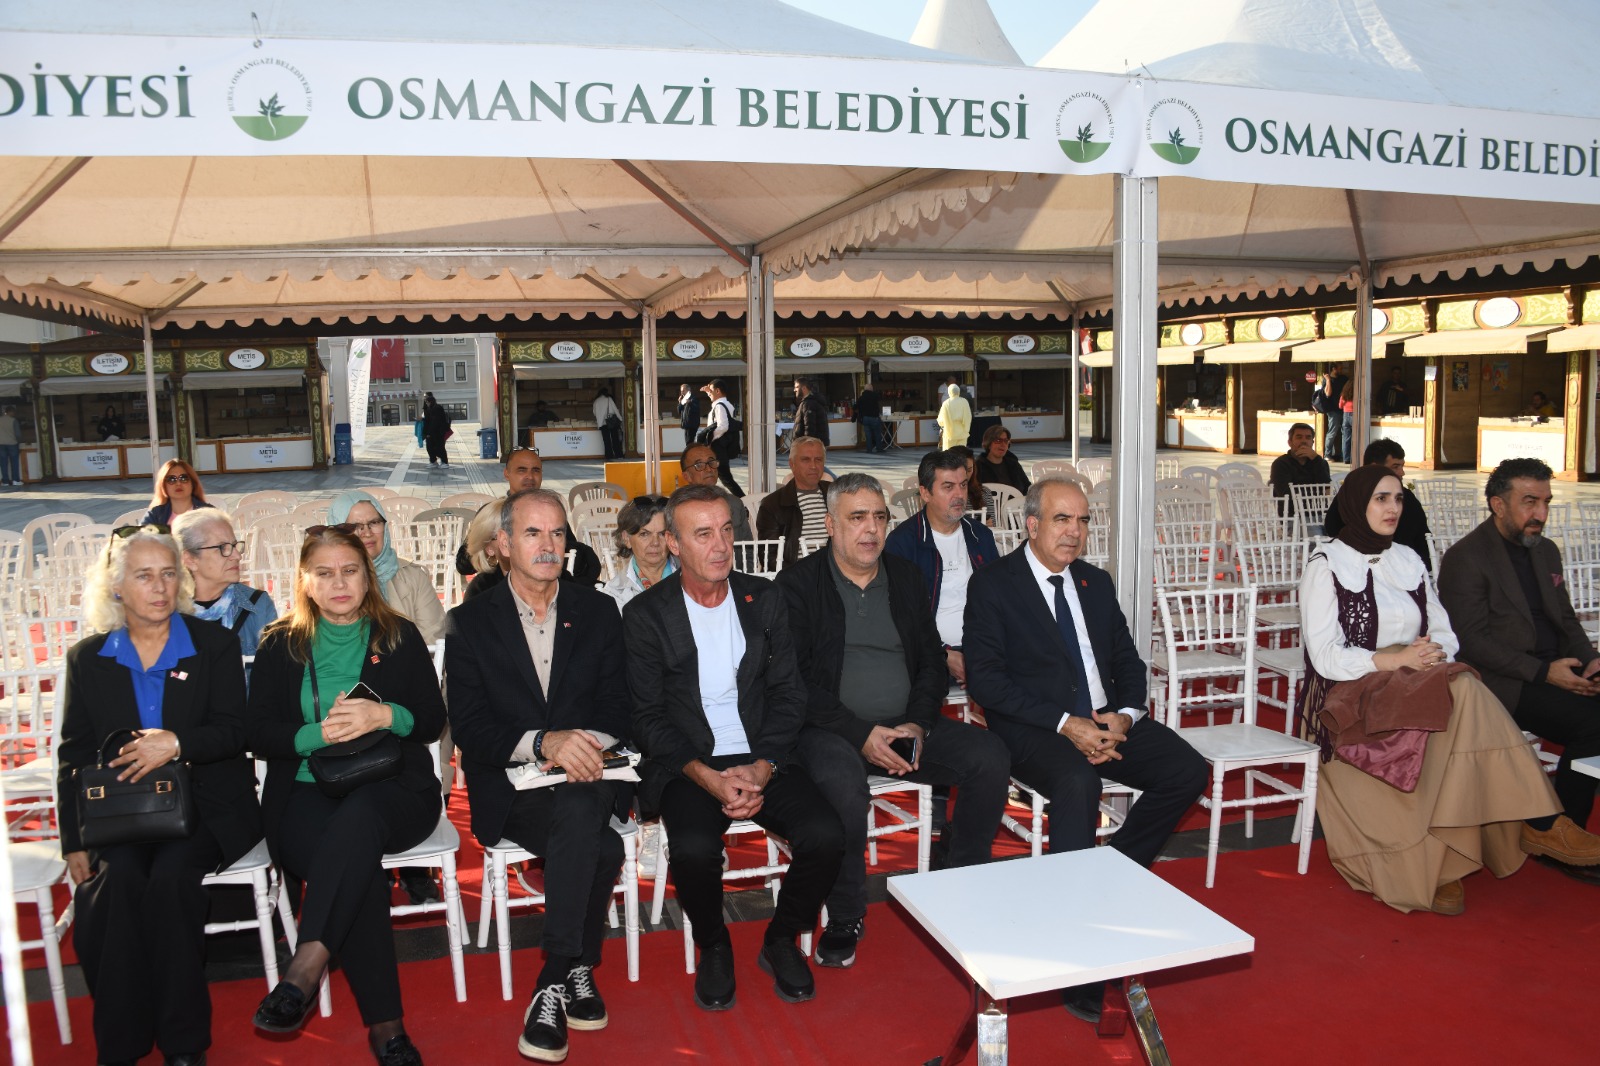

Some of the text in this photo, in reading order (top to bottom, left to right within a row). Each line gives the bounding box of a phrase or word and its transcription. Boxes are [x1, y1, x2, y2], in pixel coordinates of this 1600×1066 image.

[231, 57, 274, 85] OSMANGAZİ
[275, 58, 313, 94] BELEDİYESİ
[227, 85, 236, 112] BURSA
[347, 77, 1030, 140] OSMANGAZİ BELEDİYESİ
[1058, 90, 1091, 113] OSMANGAZİ
[1224, 117, 1600, 178] OSMANGAZİ BELEDİ
